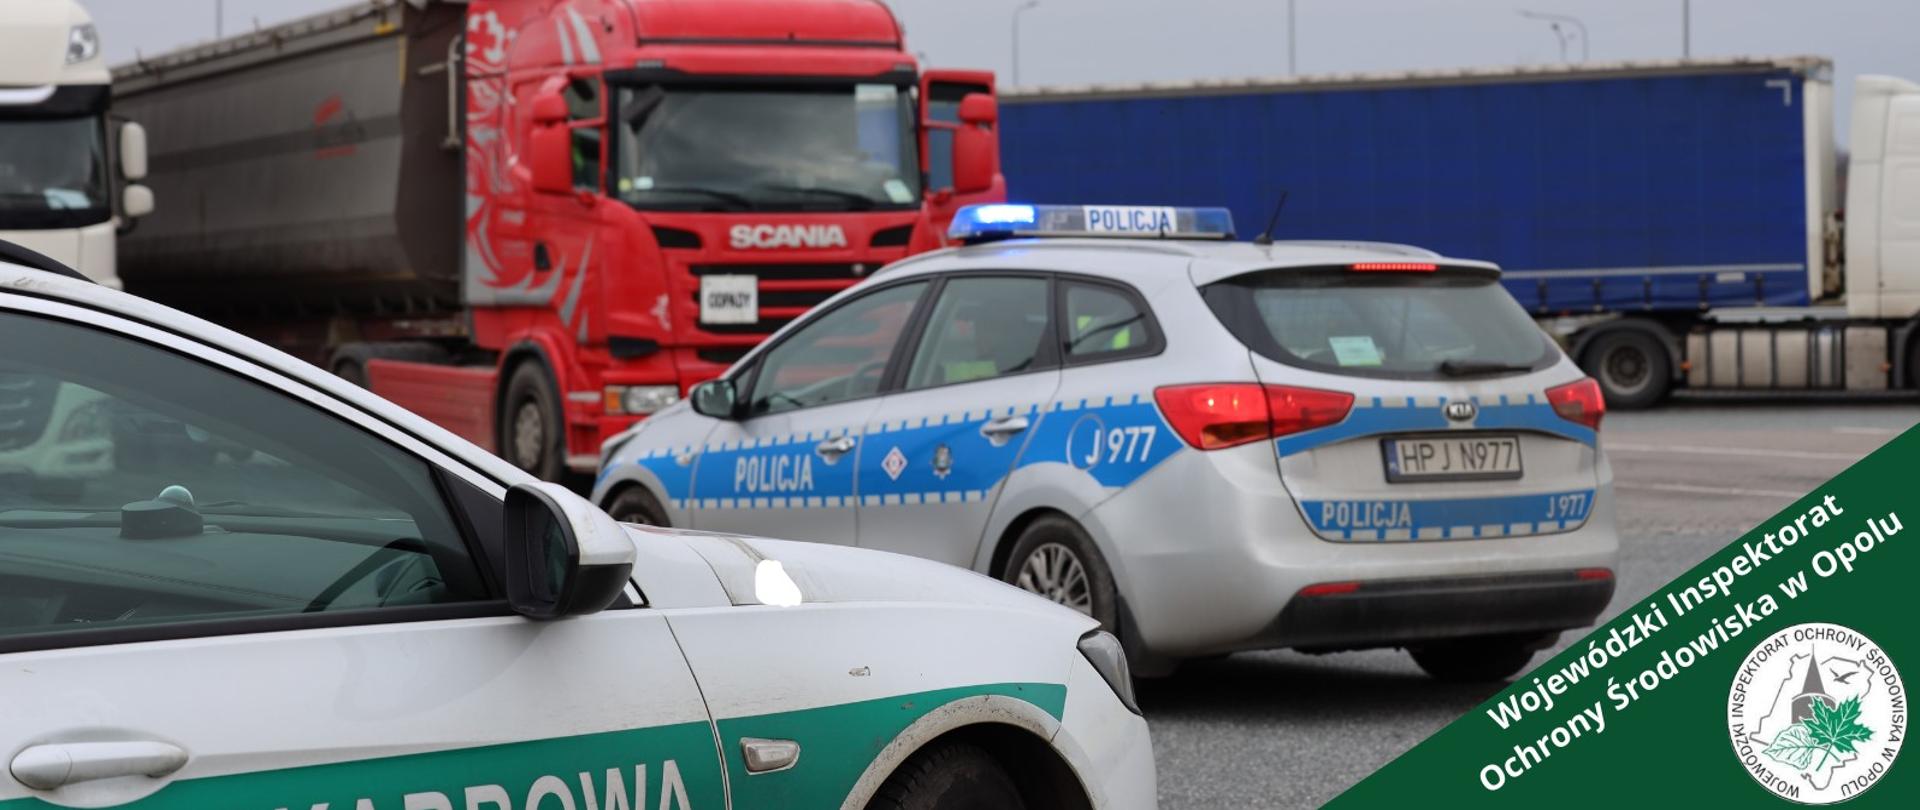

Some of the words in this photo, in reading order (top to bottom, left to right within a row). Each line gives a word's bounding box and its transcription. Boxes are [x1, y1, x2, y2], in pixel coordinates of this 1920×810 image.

[1089, 209, 1172, 232] POLICJA
[730, 224, 847, 248] SCANIA
[1449, 403, 1473, 417] KIA
[1085, 429, 1101, 465] J
[1108, 426, 1156, 463] 977
[1401, 443, 1450, 472] HPJ
[1460, 441, 1513, 470] N977
[734, 454, 814, 493] POLICJA
[1322, 501, 1412, 528] POLICJA
[1546, 496, 1556, 518] J
[1560, 494, 1586, 516] 977
